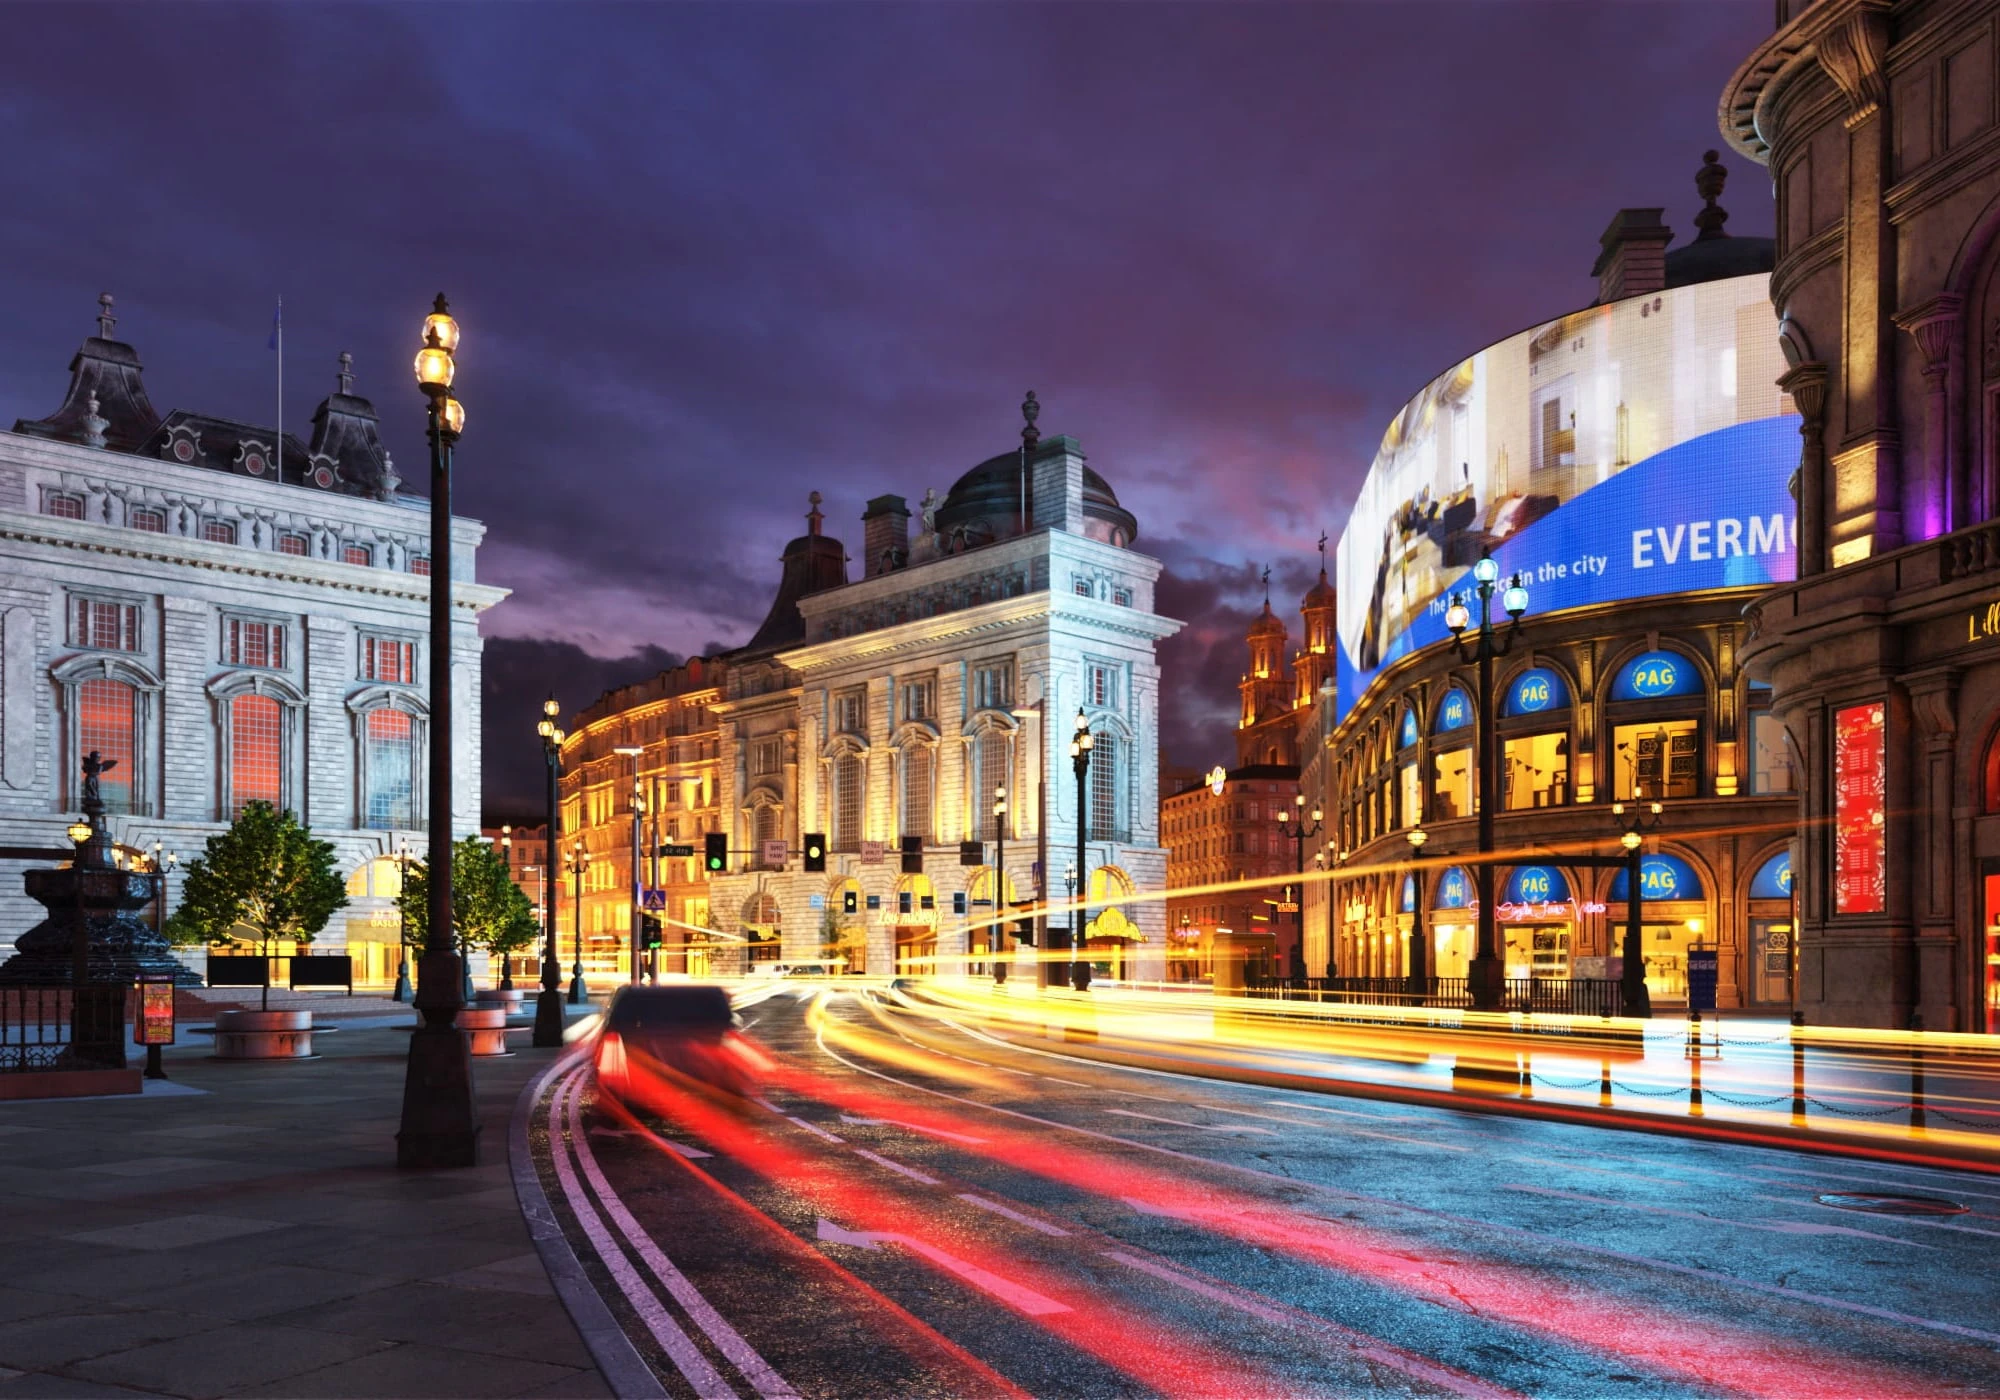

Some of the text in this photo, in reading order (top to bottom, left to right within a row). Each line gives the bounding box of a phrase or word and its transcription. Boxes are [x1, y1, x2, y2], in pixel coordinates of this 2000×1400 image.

[1429, 597, 1446, 617] The
[1447, 587, 1472, 610] bst
[1518, 569, 1534, 587] in
[1538, 562, 1567, 582] the
[1572, 555, 1608, 576] city
[1636, 668, 1674, 687] PAG
[1522, 685, 1549, 702] PAG
[1446, 704, 1462, 721] PAG
[1446, 884, 1463, 897] PAG
[1522, 877, 1549, 892] PAG
